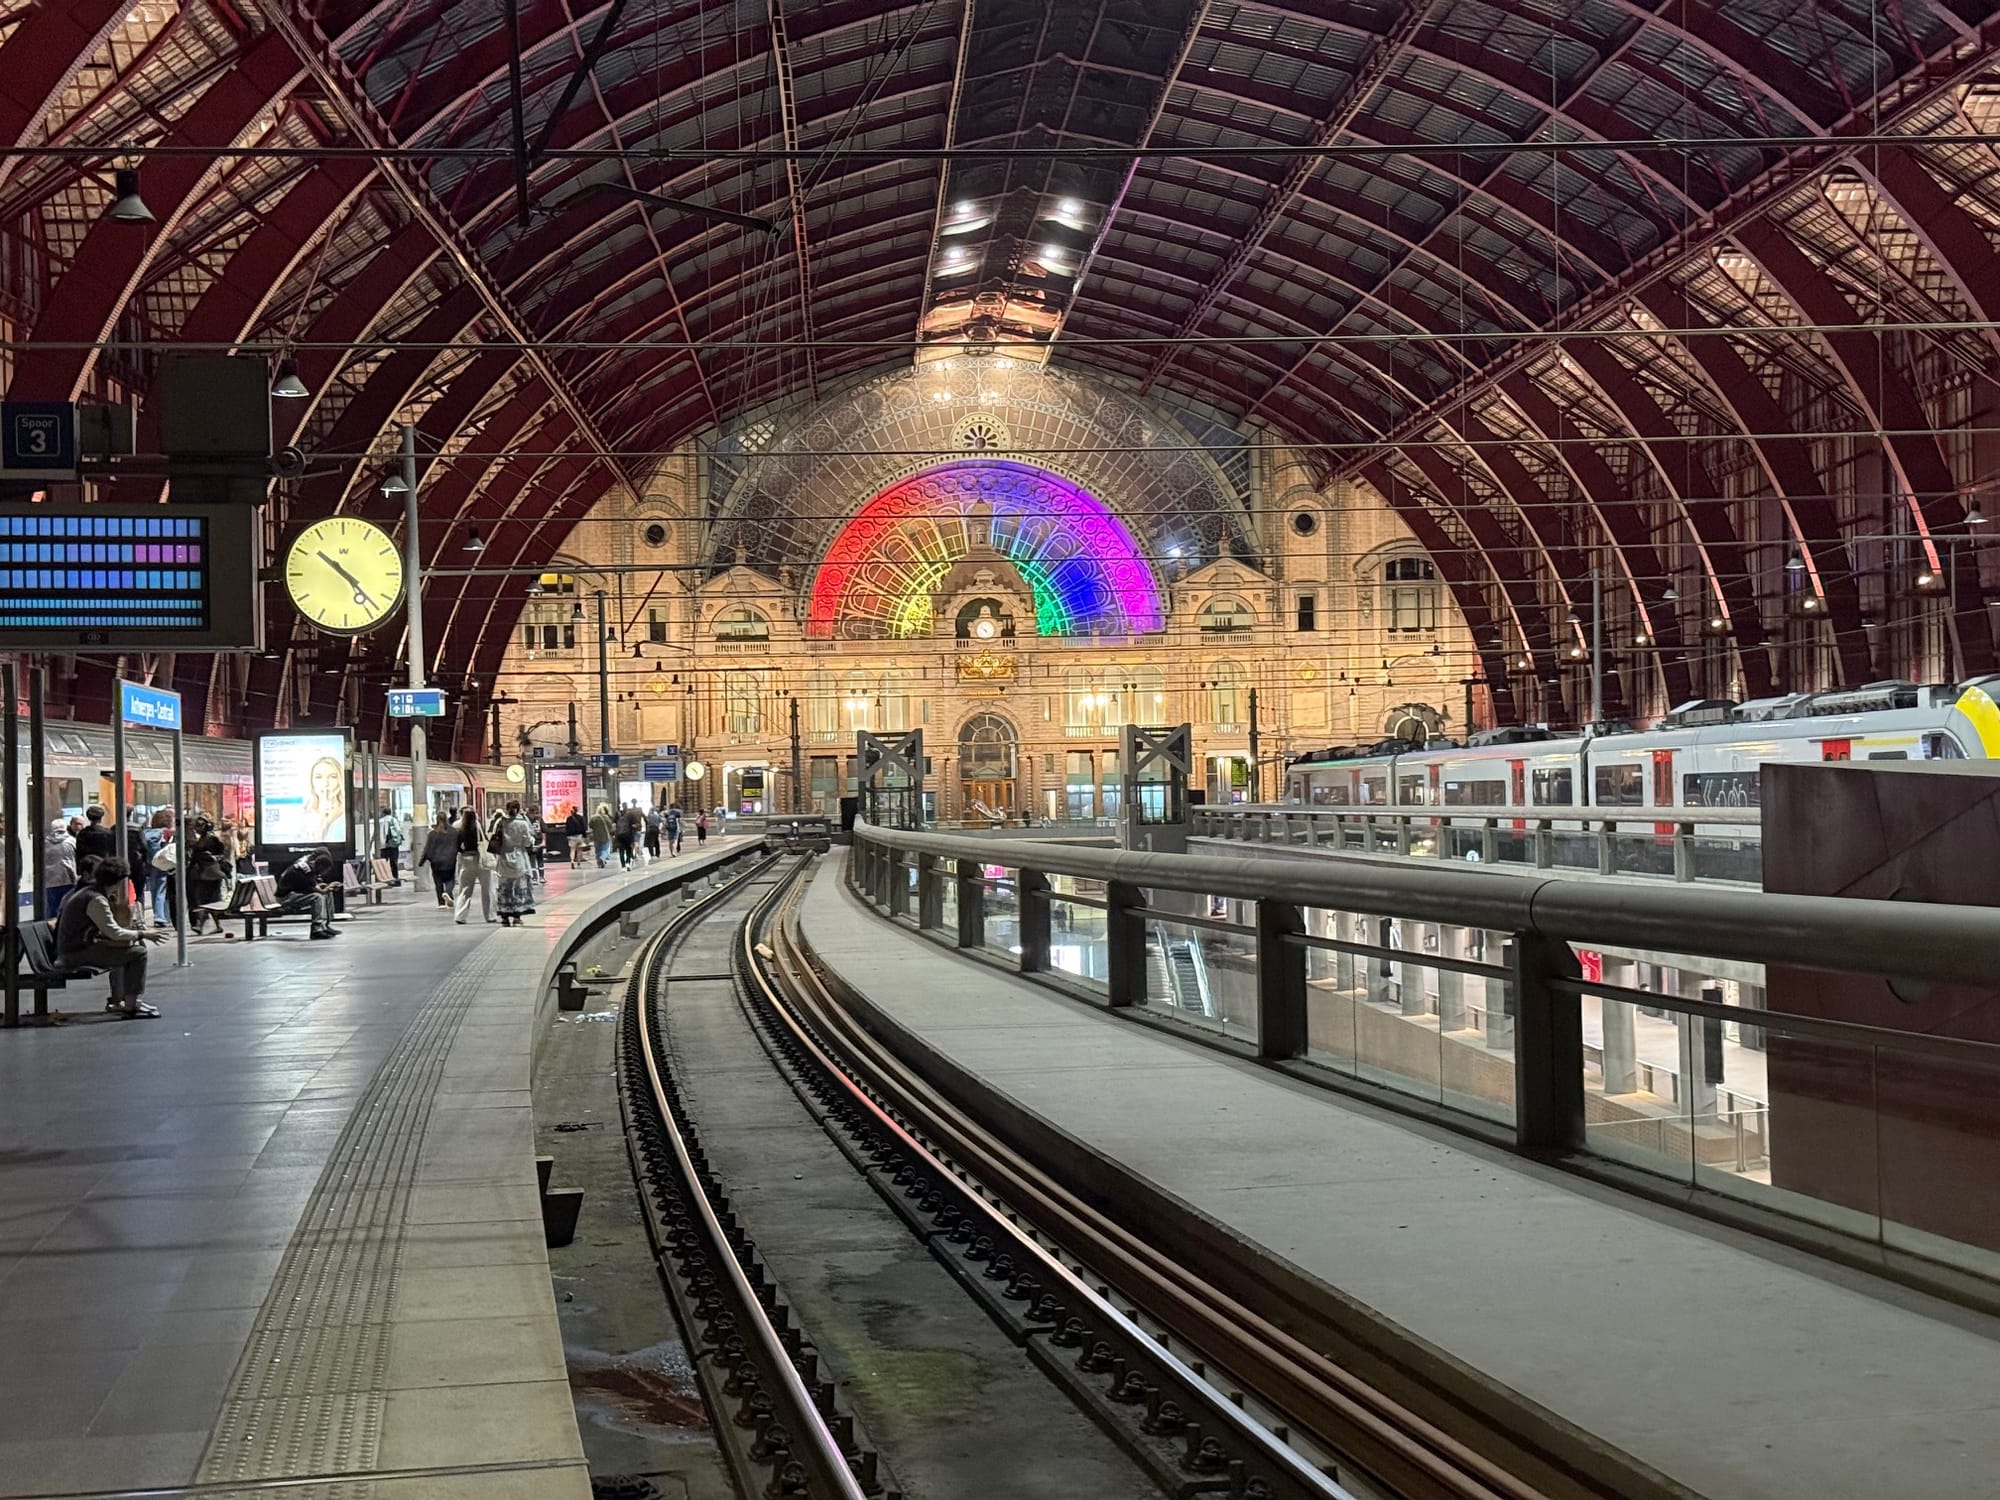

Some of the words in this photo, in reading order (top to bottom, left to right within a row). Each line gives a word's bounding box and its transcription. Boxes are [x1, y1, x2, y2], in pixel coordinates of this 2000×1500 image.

[21, 418, 54, 430] Spoor
[30, 430, 46, 452] 3
[556, 780, 577, 789] pizza
